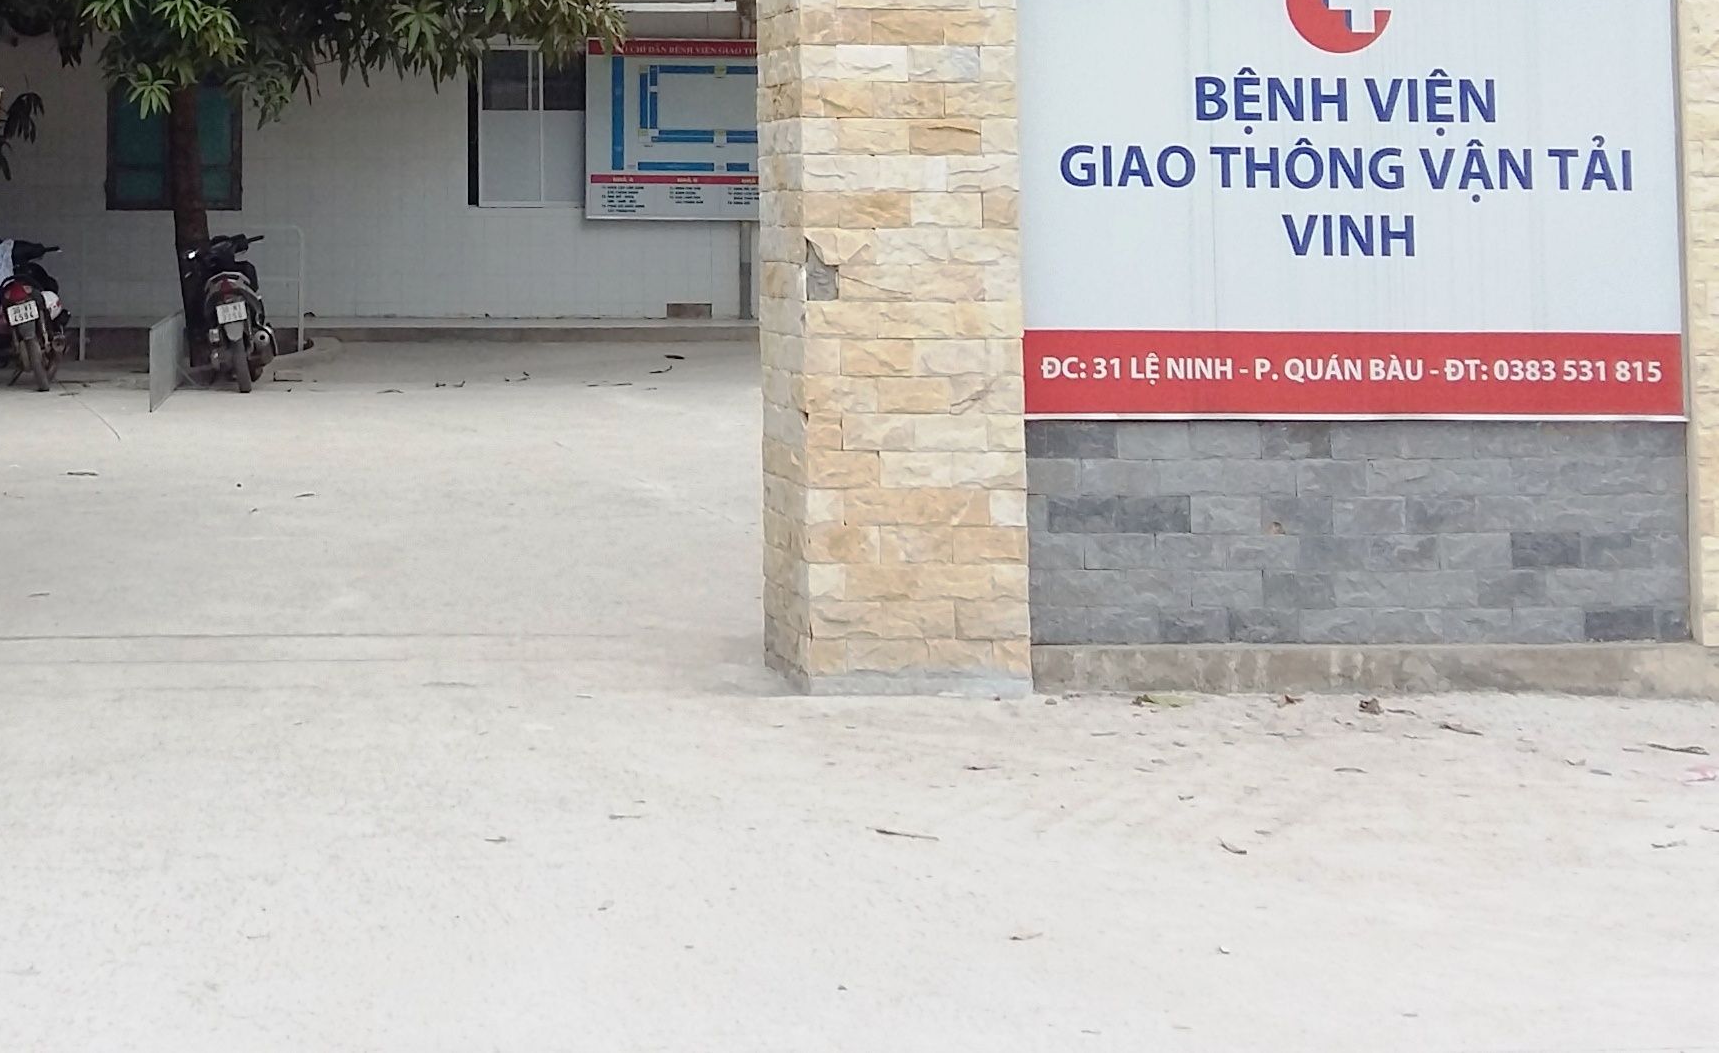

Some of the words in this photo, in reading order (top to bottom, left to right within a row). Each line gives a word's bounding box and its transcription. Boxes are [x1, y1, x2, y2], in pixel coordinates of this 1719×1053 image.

[1194, 66, 1348, 135] BỆNH
[1365, 68, 1496, 137] VIỆN
[1059, 144, 1197, 189] GIAO
[1210, 137, 1405, 190] THÔNG
[1420, 139, 1534, 204] VẬN
[1548, 135, 1633, 192] TẢI
[1282, 214, 1416, 258] VINH
[1040, 356, 1087, 379] ĐC:
[1092, 357, 1121, 379] 31
[1130, 352, 1160, 385] LỆ
[1166, 357, 1233, 380] NINH
[1254, 358, 1279, 381] P.
[1284, 354, 1363, 383] QUÁN
[1369, 354, 1423, 381] BÀU
[1444, 358, 1488, 381] ĐT:
[1493, 359, 1557, 381] 0383
[1562, 359, 1606, 382] 531
[1614, 360, 1662, 383] 815
